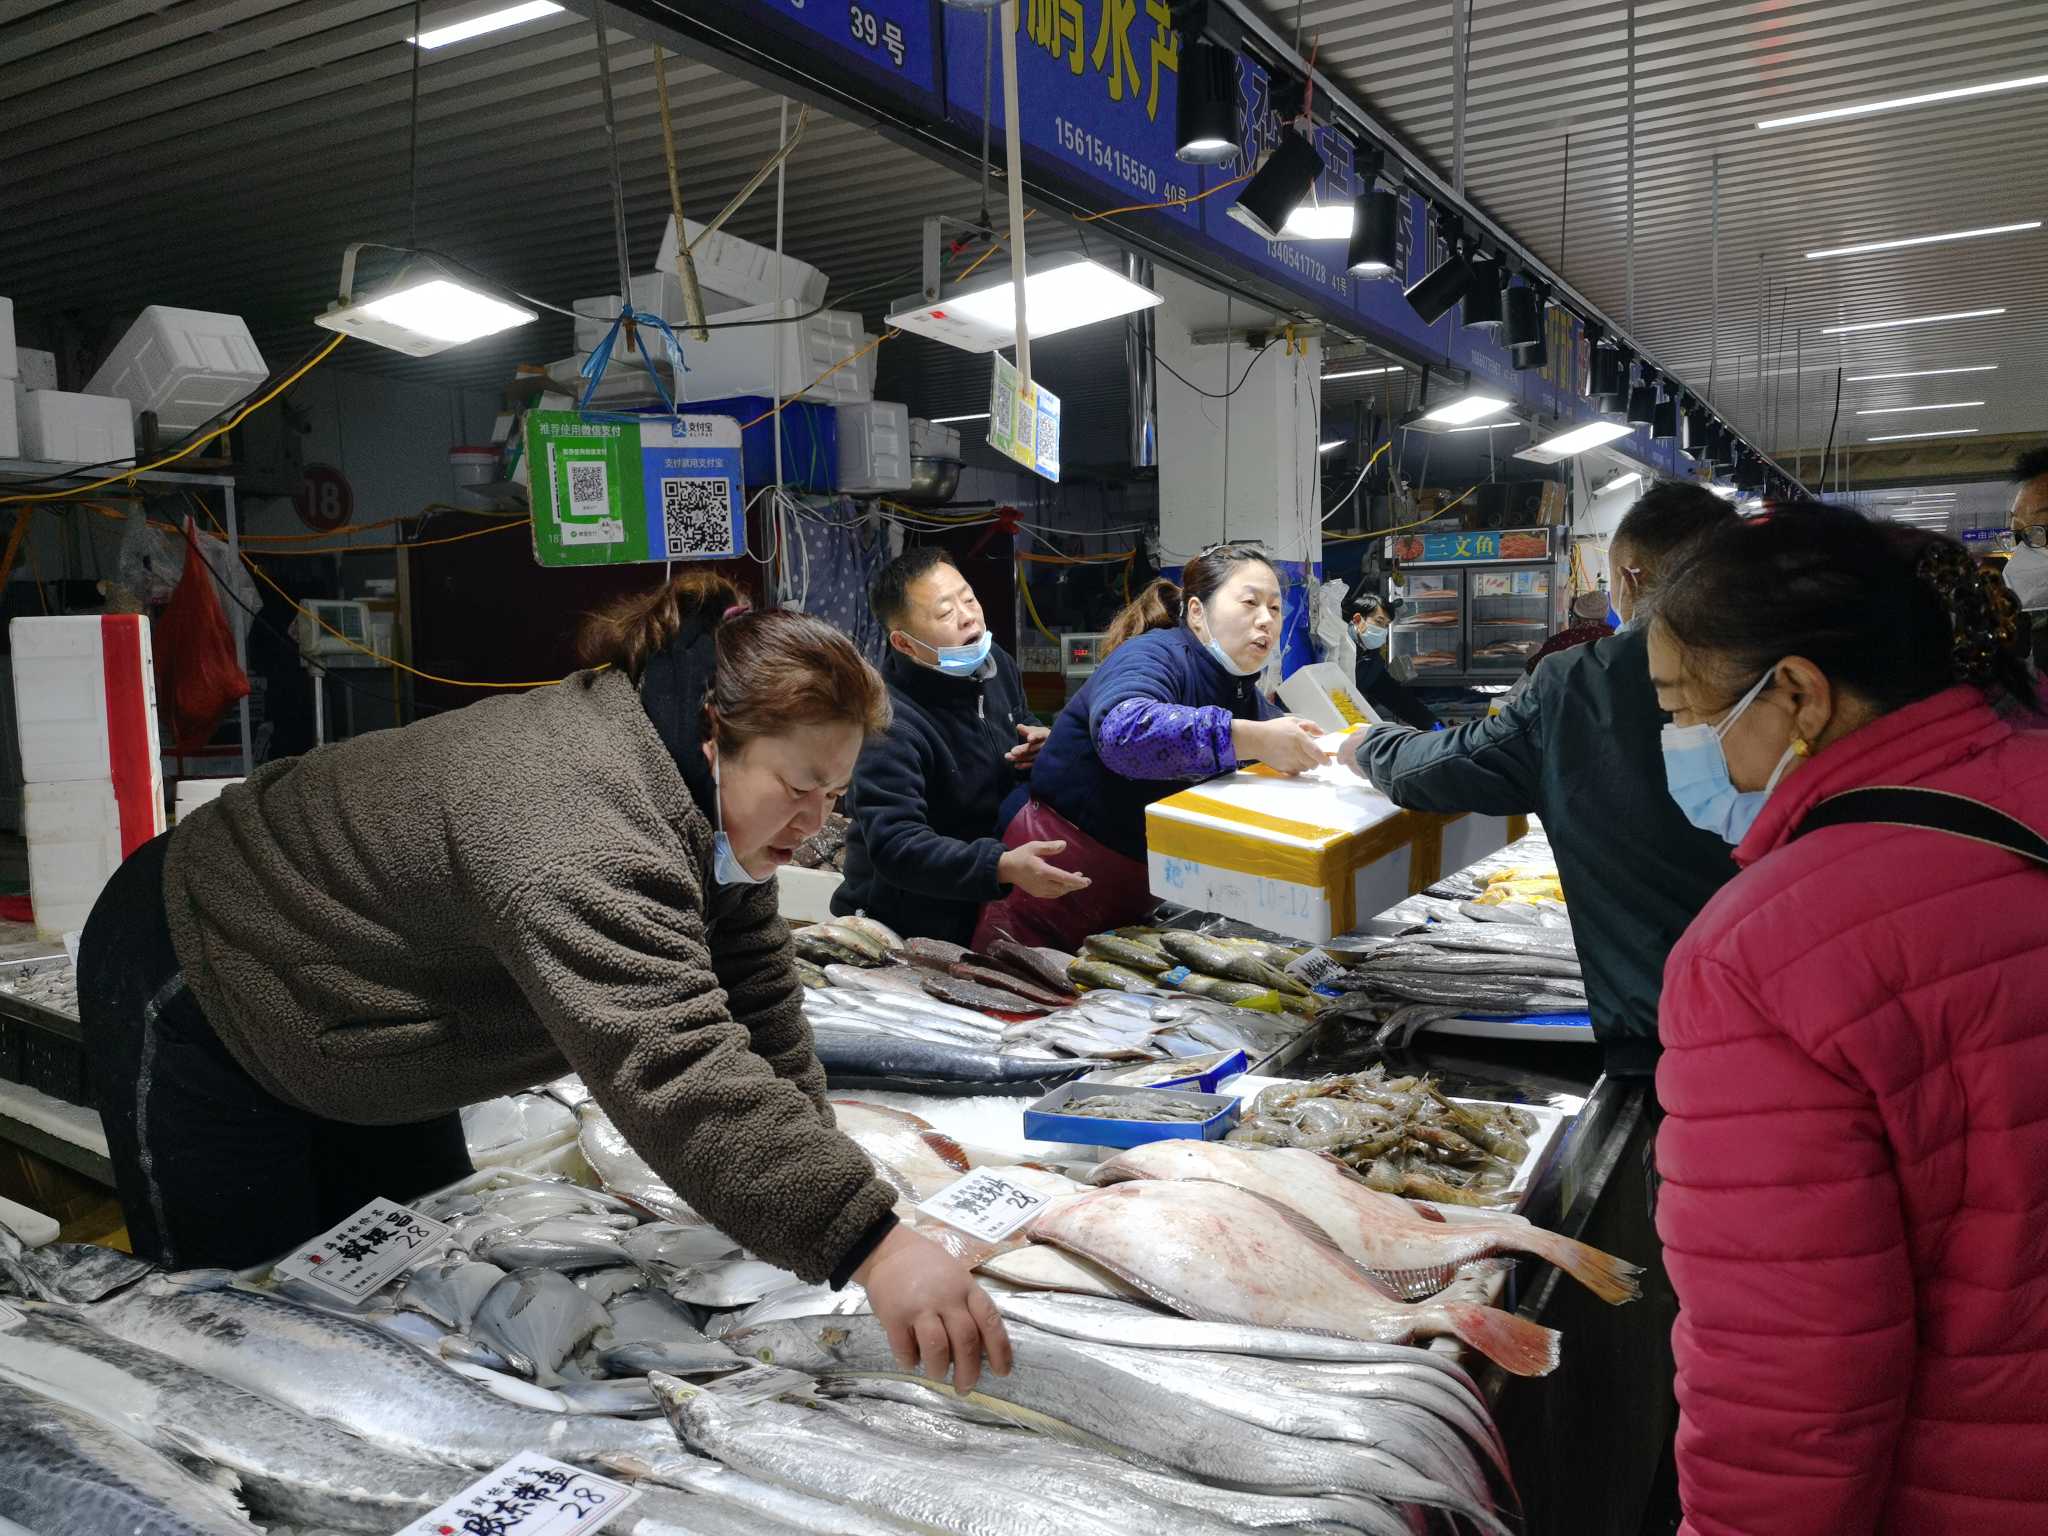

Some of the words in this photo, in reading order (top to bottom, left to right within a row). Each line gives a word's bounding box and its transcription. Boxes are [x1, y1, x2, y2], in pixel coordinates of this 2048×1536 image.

[850, 5, 905, 66] 39号
[1055, 115, 1157, 195] 15615415550
[1163, 181, 1188, 212] 40号
[1267, 240, 1327, 284] 13405417728
[539, 424, 621, 437] 推荐使用微信支付
[688, 422, 713, 432] 支付宝
[1006, 1189, 1039, 1209] 28
[394, 1225, 430, 1249] 28
[559, 1487, 606, 1519] 28
